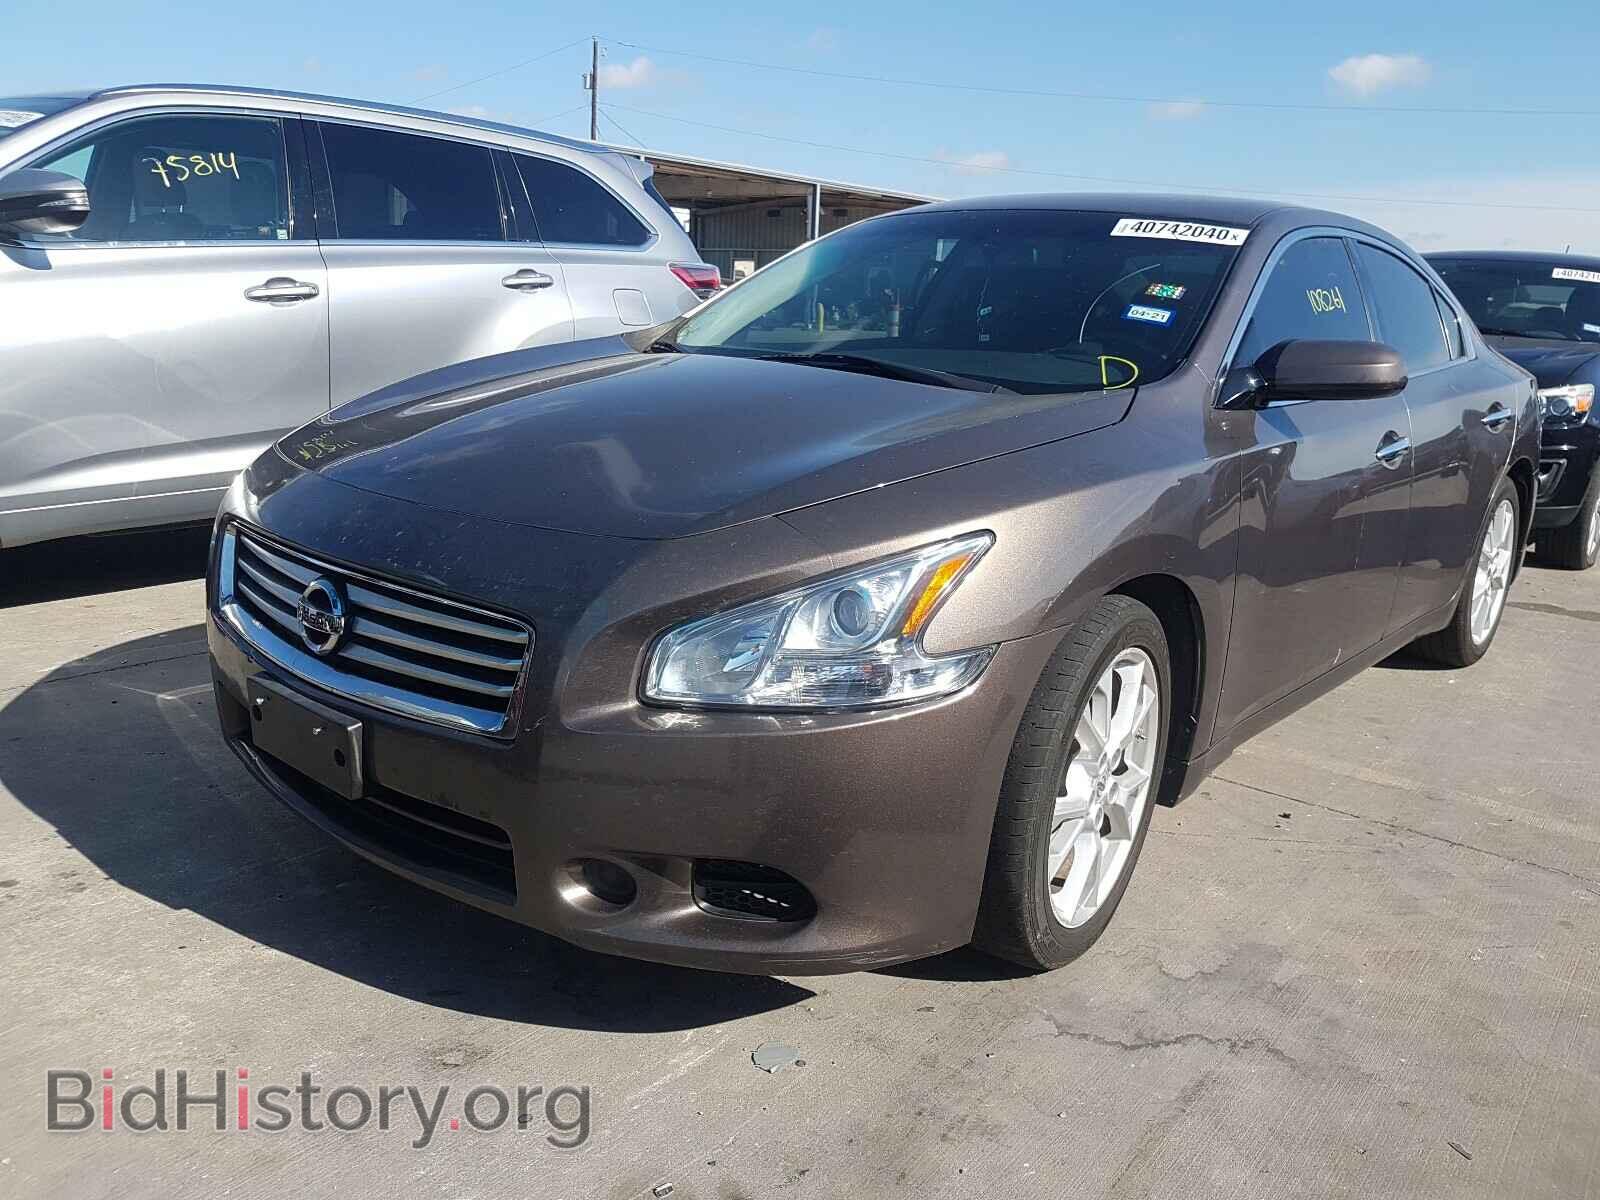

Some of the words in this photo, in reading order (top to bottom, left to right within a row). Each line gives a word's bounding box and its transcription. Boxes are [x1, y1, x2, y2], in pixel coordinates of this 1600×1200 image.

[142, 152, 240, 188] 75814
[1130, 221, 1230, 241] 40742040
[1097, 355, 1138, 390] D
